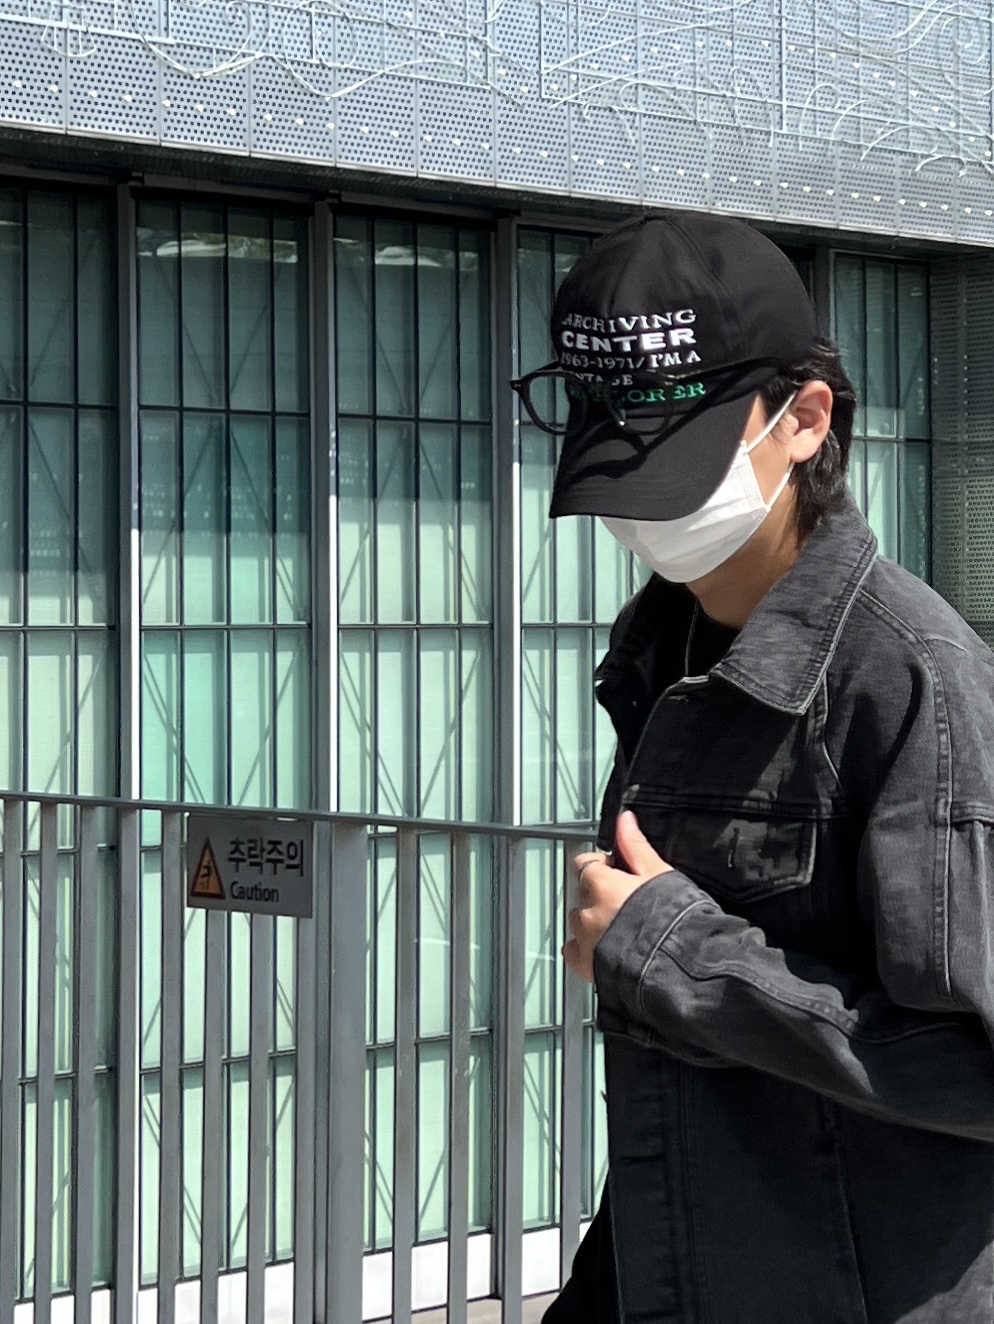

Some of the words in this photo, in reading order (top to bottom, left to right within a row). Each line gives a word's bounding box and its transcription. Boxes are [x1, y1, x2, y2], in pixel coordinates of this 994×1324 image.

[561, 308, 697, 333] ARCHIVING
[562, 327, 697, 352] CENTER
[686, 350, 702, 363] A
[227, 836, 304, 877] 추락주의
[230, 881, 280, 903] Caution
